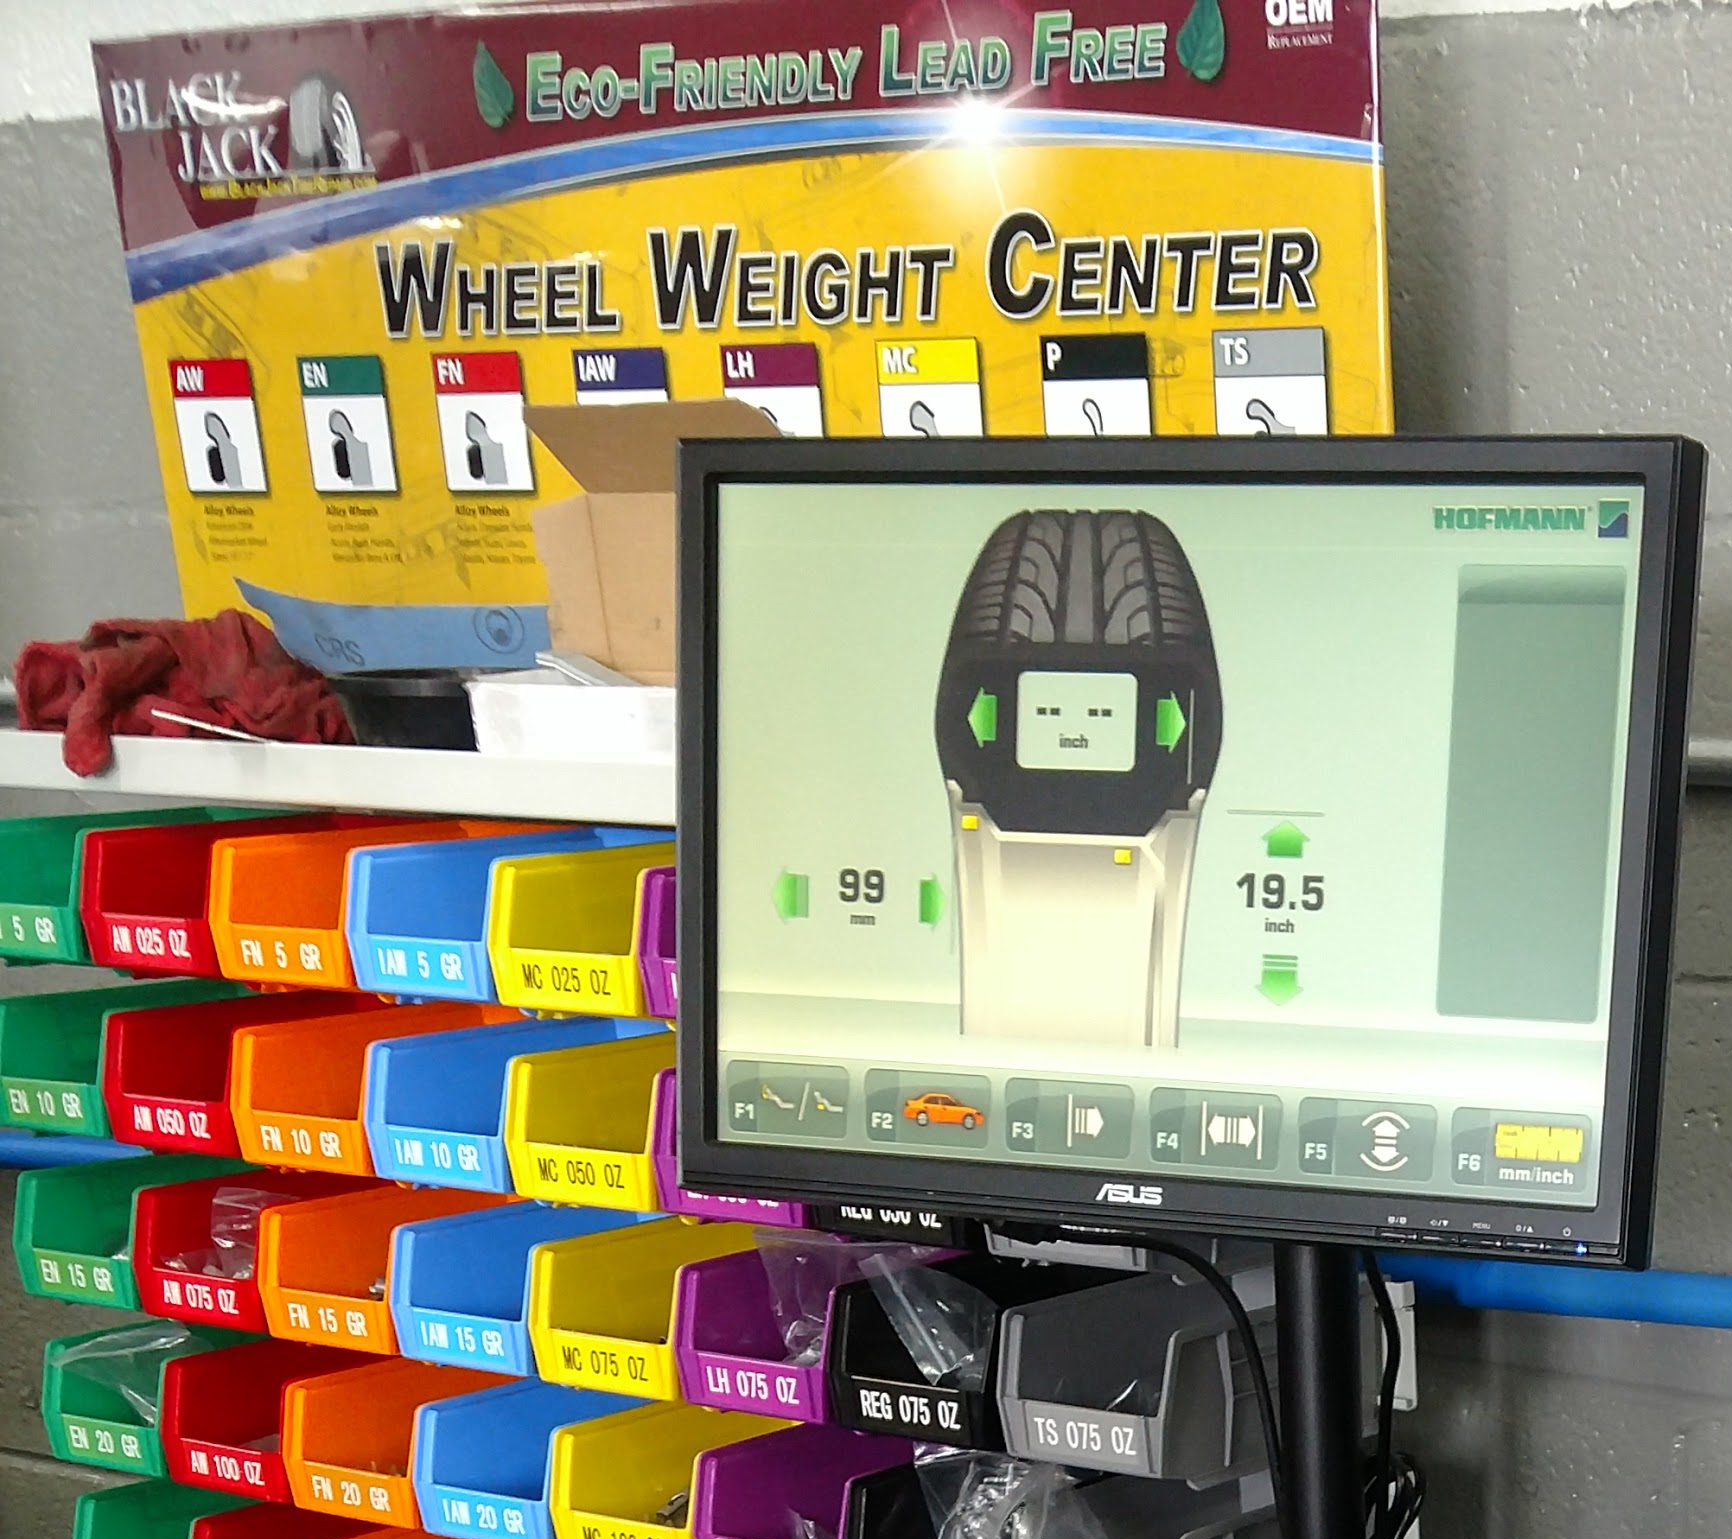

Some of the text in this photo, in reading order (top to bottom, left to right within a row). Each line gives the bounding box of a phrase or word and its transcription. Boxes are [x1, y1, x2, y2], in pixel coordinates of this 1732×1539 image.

[1264, 0, 1334, 26] OEM
[177, 124, 285, 183] JACK
[725, 353, 755, 378] LH
[881, 347, 917, 375] MC
[1046, 343, 1062, 370] P
[1219, 337, 1249, 366] TS
[175, 366, 204, 392] AW
[301, 363, 329, 389] EN
[437, 359, 463, 384] FN
[577, 354, 615, 382] IAW
[1433, 506, 1586, 531] HOFMANN
[1059, 733, 1088, 750] inch
[839, 868, 885, 904] 99
[1236, 873, 1325, 912] 19.5
[850, 914, 875, 926] mm
[1264, 918, 1295, 934] inch
[136, 928, 164, 955] 025
[169, 929, 191, 958] OZ
[240, 939, 322, 971] FN 5 GR
[418, 951, 430, 979] 5
[440, 952, 464, 981] GR
[522, 964, 611, 996] MC 025 OZ
[9, 1089, 82, 1118] EN 10 GR
[734, 1102, 755, 1120] F1
[871, 1112, 893, 1129] F2
[1012, 1121, 1033, 1139] F3
[261, 1125, 342, 1158] FN 10 GR
[1156, 1132, 1179, 1150] F4
[1304, 1142, 1327, 1160] F5
[431, 1141, 450, 1169] 10
[458, 1143, 480, 1172] GR
[1457, 1153, 1481, 1171] F6
[538, 1157, 624, 1189] MC 050 OZ
[1499, 1166, 1574, 1185] mm/inch
[1096, 1183, 1163, 1206] ASUS
[41, 1259, 113, 1292] EN 15 GR
[186, 1283, 212, 1310] 075
[218, 1289, 239, 1315] OZ
[287, 1303, 367, 1337] FN 15 GR
[455, 1326, 475, 1351] 15
[482, 1329, 504, 1356] GR
[563, 1345, 648, 1382] MC 075 OZ
[706, 1365, 799, 1404] LH 075 OZ
[860, 1389, 961, 1430] REG 075 OZ
[69, 1424, 141, 1459] EN 20 GR
[1033, 1417, 1136, 1456] TS 075 OZ
[312, 1475, 391, 1512] FN 20 GR
[476, 1504, 498, 1529] 20
[504, 1508, 525, 1536] GR
